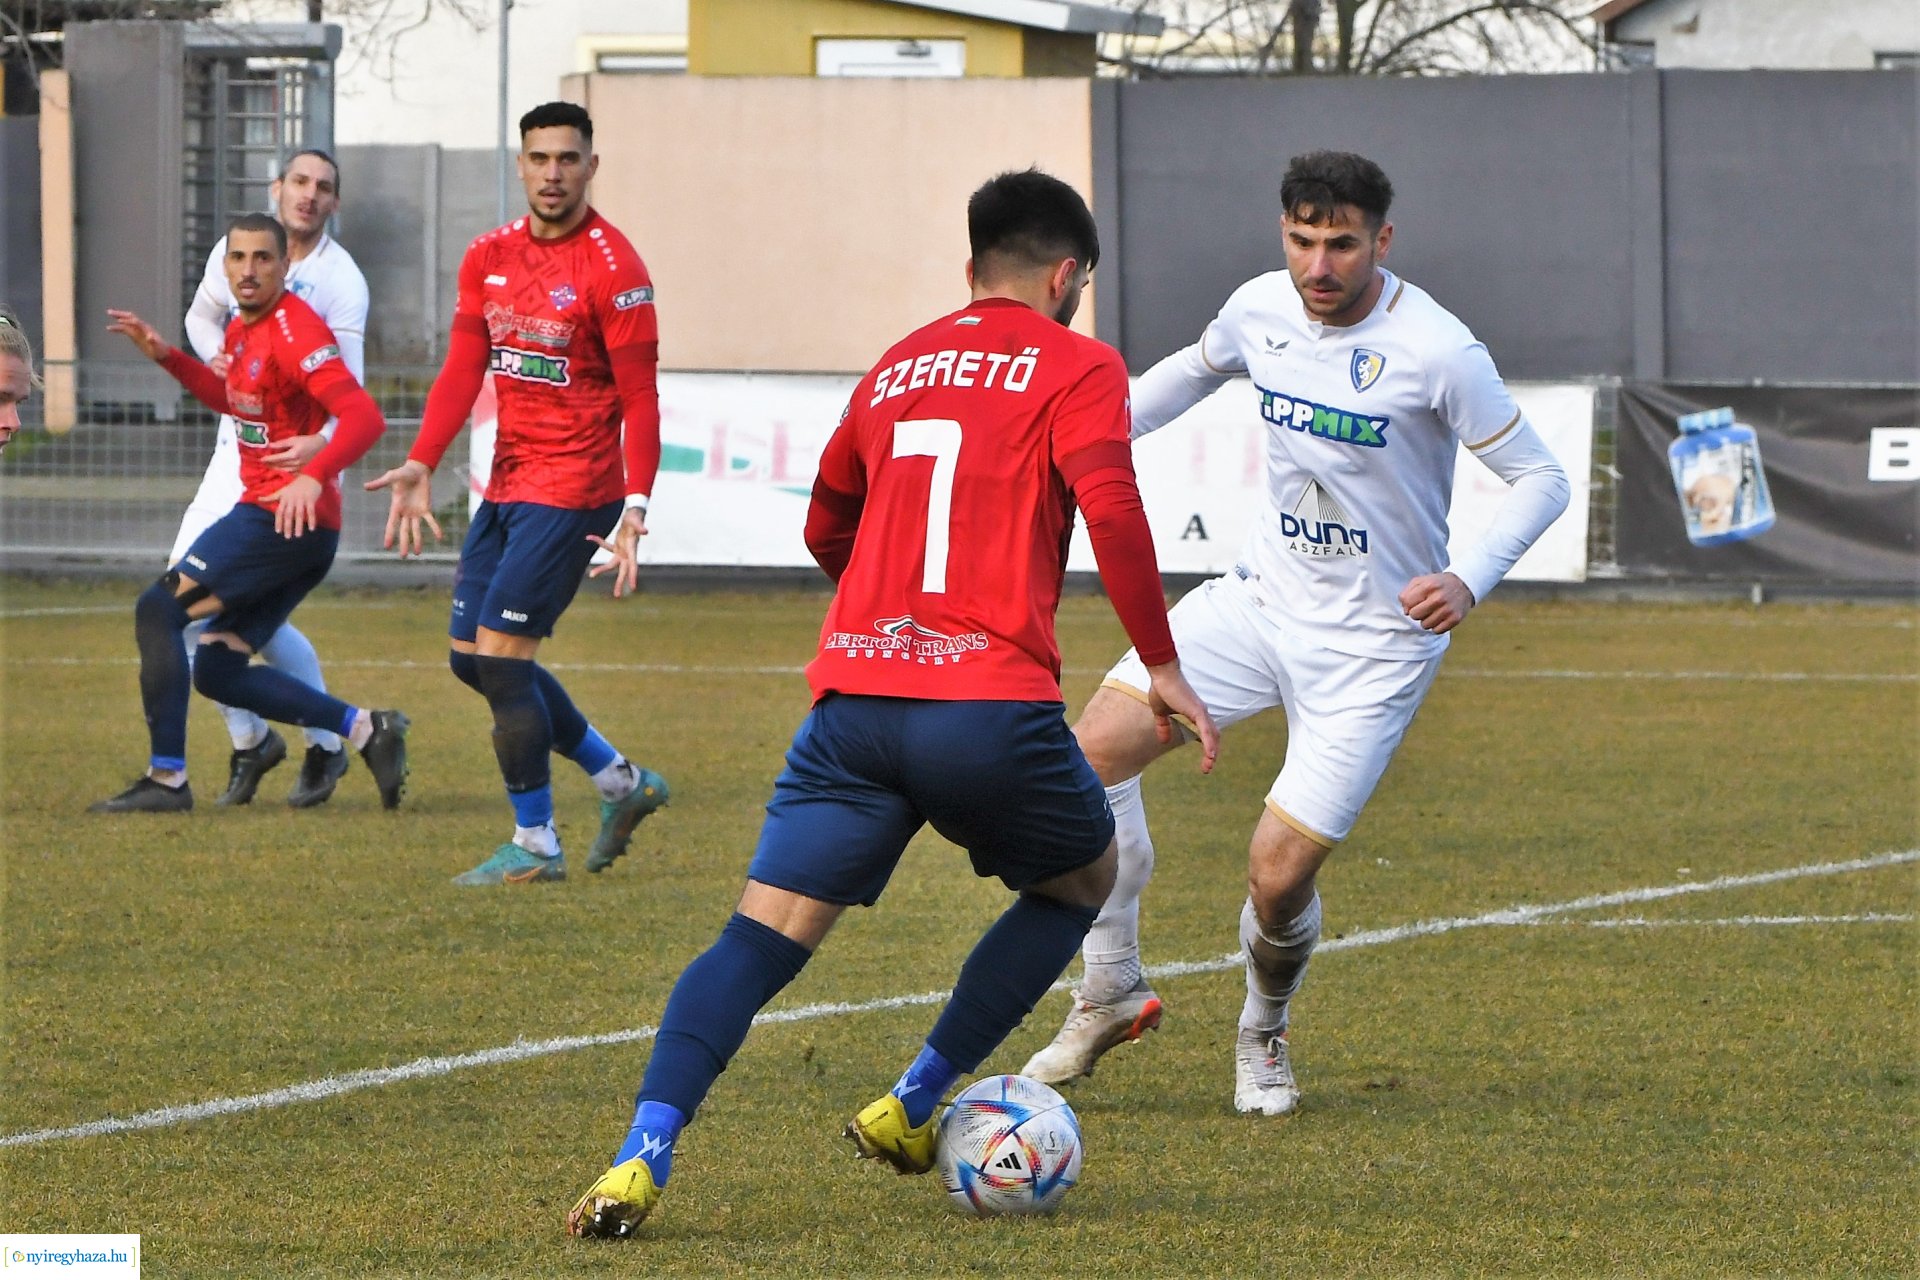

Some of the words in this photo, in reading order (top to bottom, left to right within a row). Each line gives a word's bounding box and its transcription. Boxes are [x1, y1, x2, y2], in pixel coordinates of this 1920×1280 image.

[870, 346, 1040, 408] SZERETŐ
[892, 419, 962, 593] 7
[1289, 541, 1362, 558] ASZFAL
[846, 649, 961, 665] HUNGARY
[914, 633, 989, 657] TRANS
